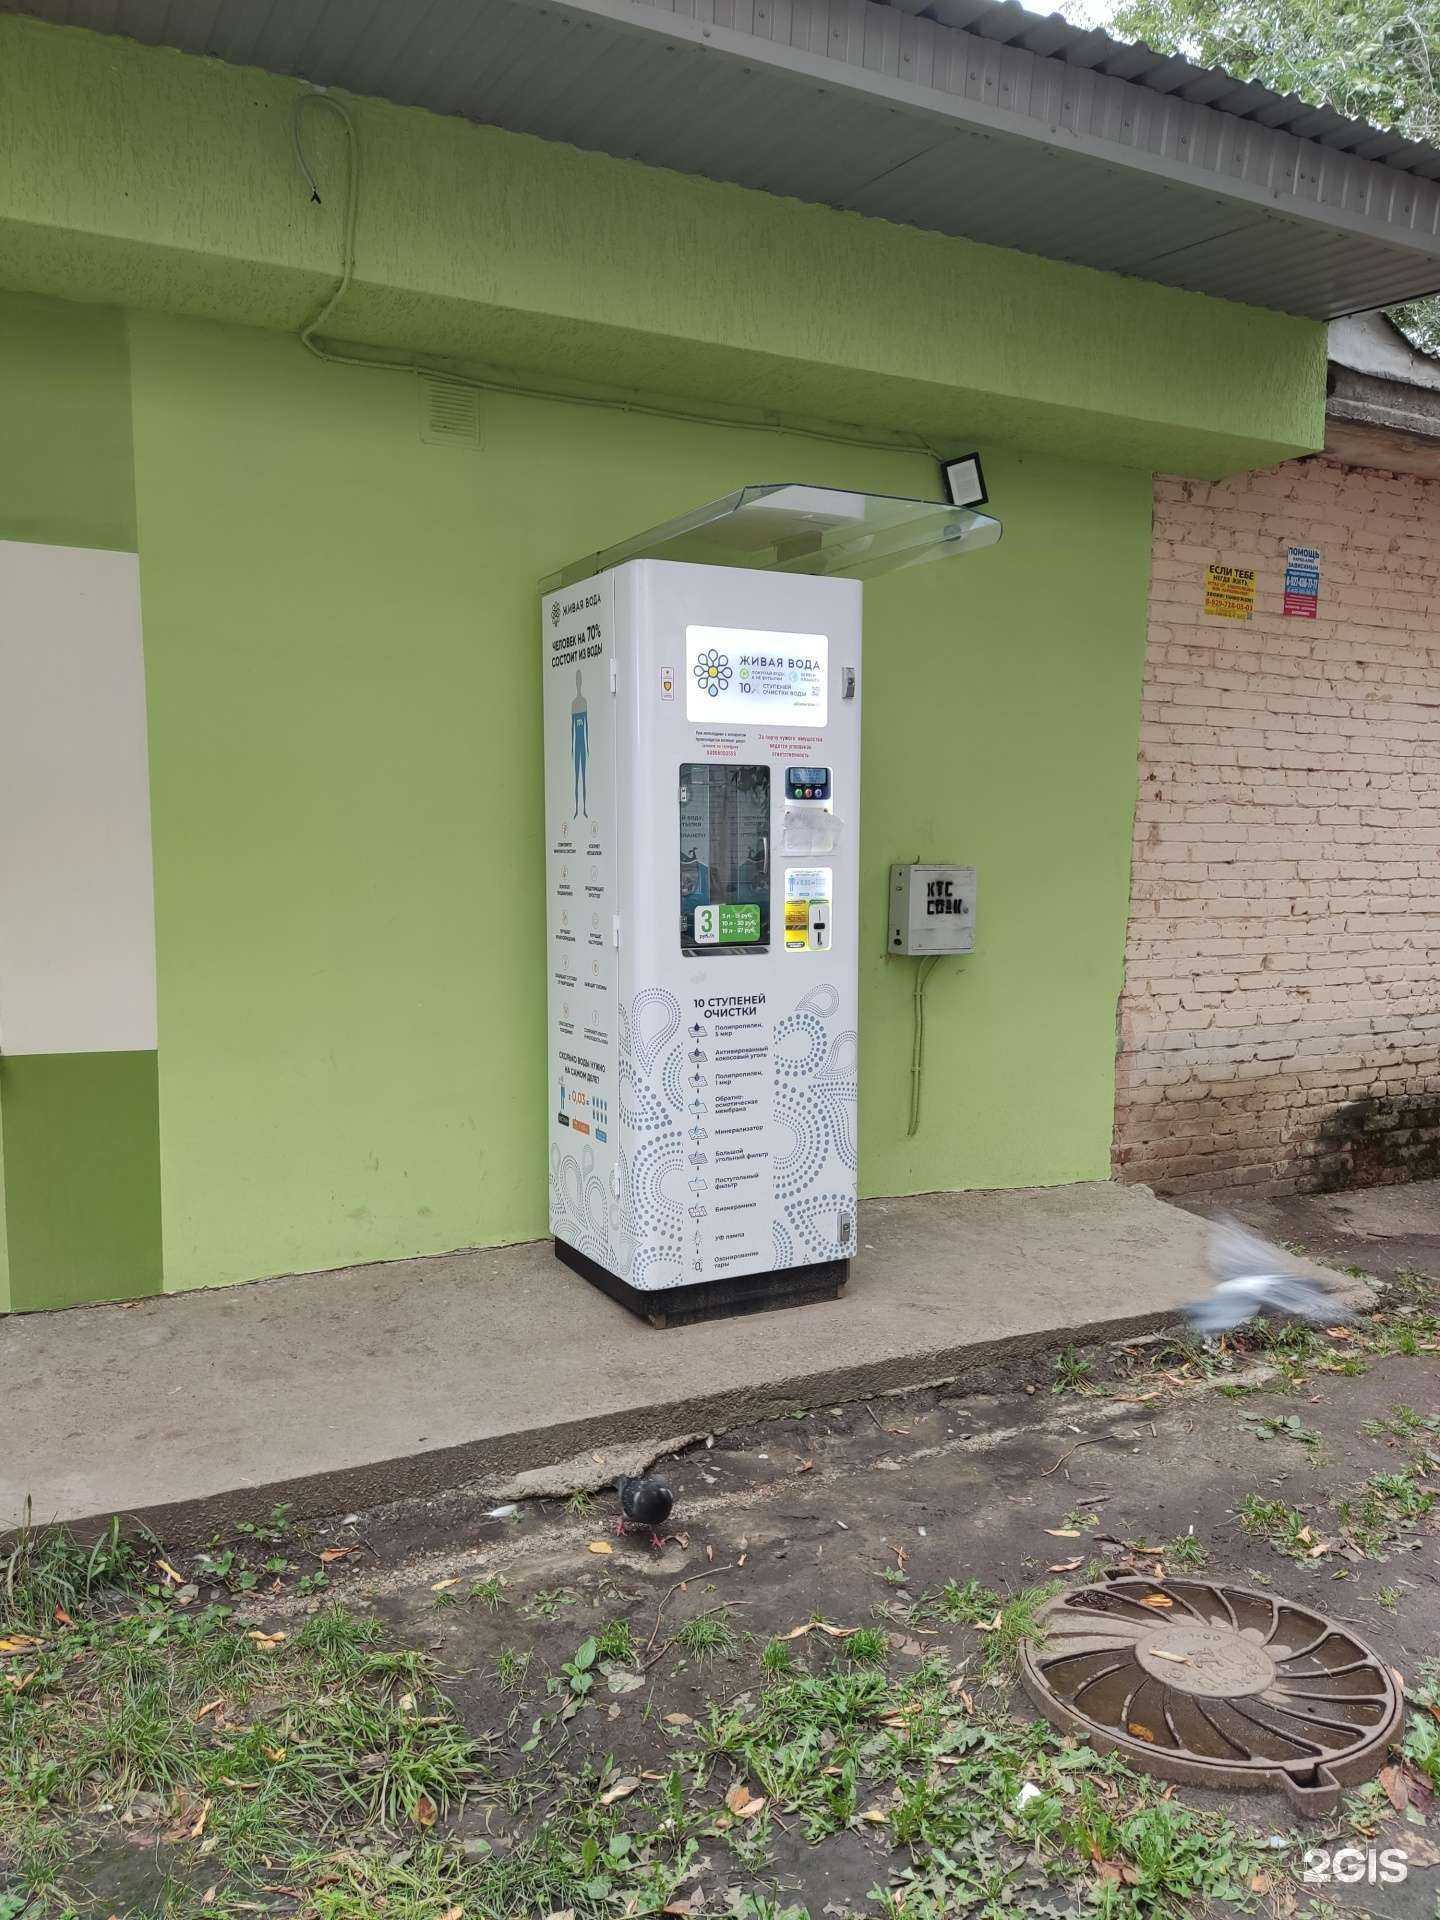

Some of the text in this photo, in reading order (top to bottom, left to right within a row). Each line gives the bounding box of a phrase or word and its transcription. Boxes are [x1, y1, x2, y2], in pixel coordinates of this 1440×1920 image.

[1288, 547, 1319, 560] ПОМОЩЬ
[1209, 565, 1255, 580] ЕСЛИ ТЕБЕ
[562, 593, 601, 616] ЖИВАЯ ВОДА
[552, 623, 602, 651] ЧЕЛОВЕК НА 70%
[551, 642, 603, 667] СОСТОИТ ИЗ ВОДЫ
[740, 656, 820, 670] ЖИВАЯ ВОДА
[739, 683, 751, 694] 10
[927, 880, 954, 897] КТС
[701, 909, 713, 933] 3
[694, 992, 766, 1008] 10 СТУПЕНЕЙ
[704, 1006, 757, 1018] ОЧИСТКИ
[570, 1068, 587, 1080] САМОМ
[571, 1090, 586, 1106] 0,03
[715, 1099, 758, 1108] осмотическая
[715, 1125, 764, 1135] Минерализатор
[715, 1147, 744, 1156] Большой
[715, 1154, 745, 1163] угольный
[715, 1182, 738, 1190] фильтр
[725, 1232, 745, 1240] лампа
[714, 1251, 759, 1262] Озонирование
